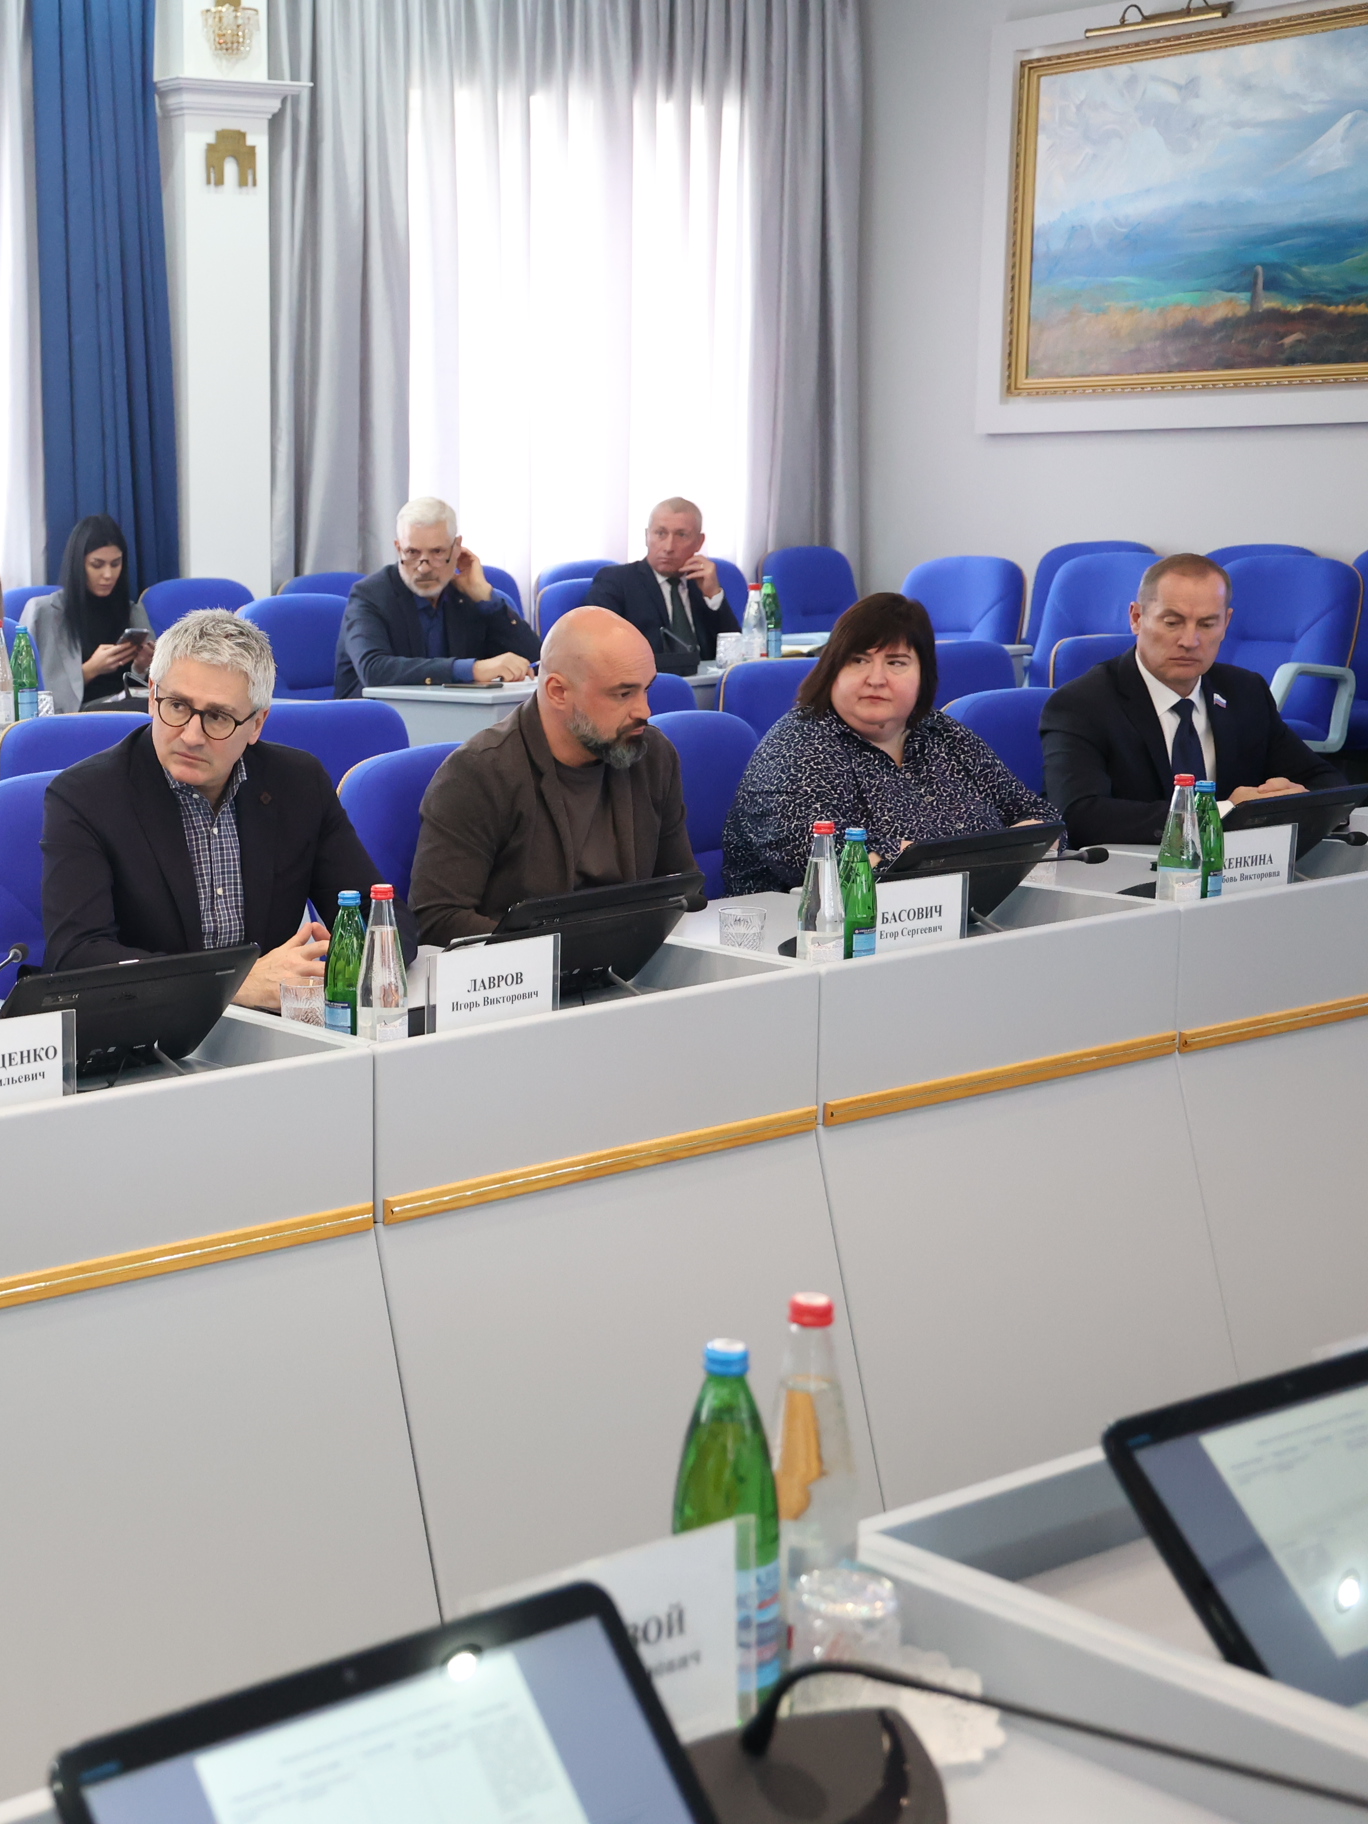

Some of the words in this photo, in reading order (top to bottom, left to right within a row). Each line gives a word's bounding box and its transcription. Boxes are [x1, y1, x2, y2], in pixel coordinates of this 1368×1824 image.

[1239, 870, 1280, 881] Викторовна
[881, 904, 942, 925] БАСОВИЧ
[879, 930, 899, 940] Егор
[900, 925, 943, 938] Сергеевич
[467, 971, 524, 993] ЛАВРОВ
[451, 1000, 480, 1012] Игорь
[483, 990, 539, 1006] Викторович
